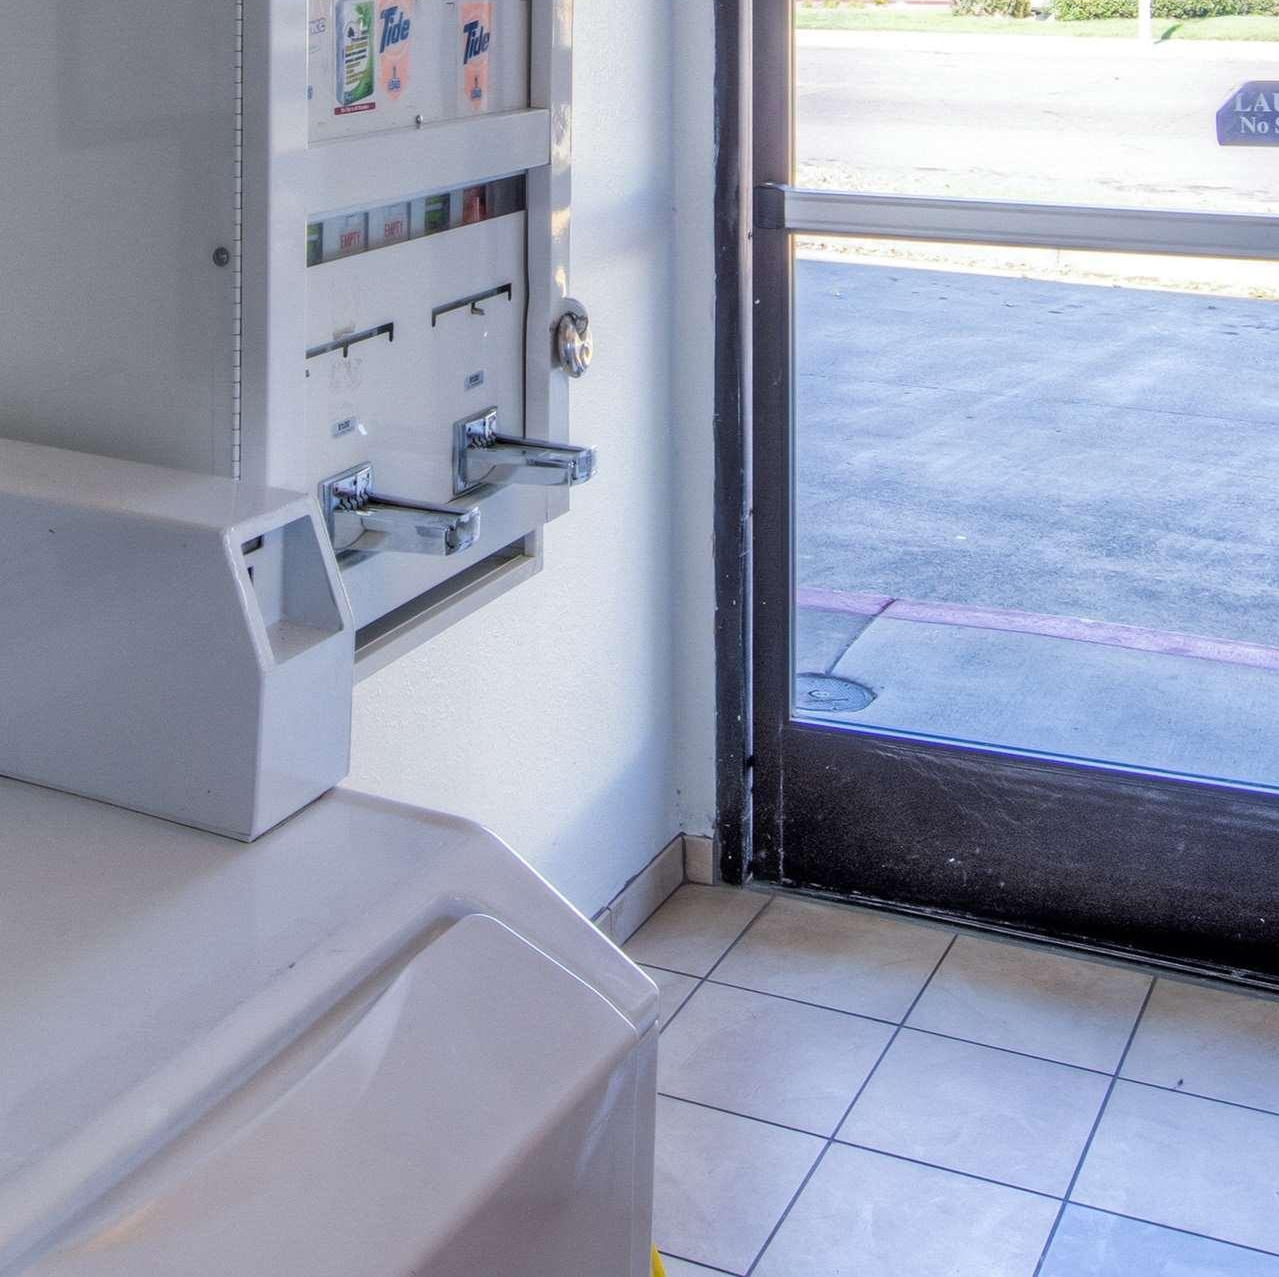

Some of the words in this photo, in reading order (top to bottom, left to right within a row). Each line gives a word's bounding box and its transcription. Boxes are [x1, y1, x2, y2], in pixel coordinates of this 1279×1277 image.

[379, 5, 411, 54] Tide
[463, 19, 490, 65] Tide
[1240, 116, 1269, 134] No
